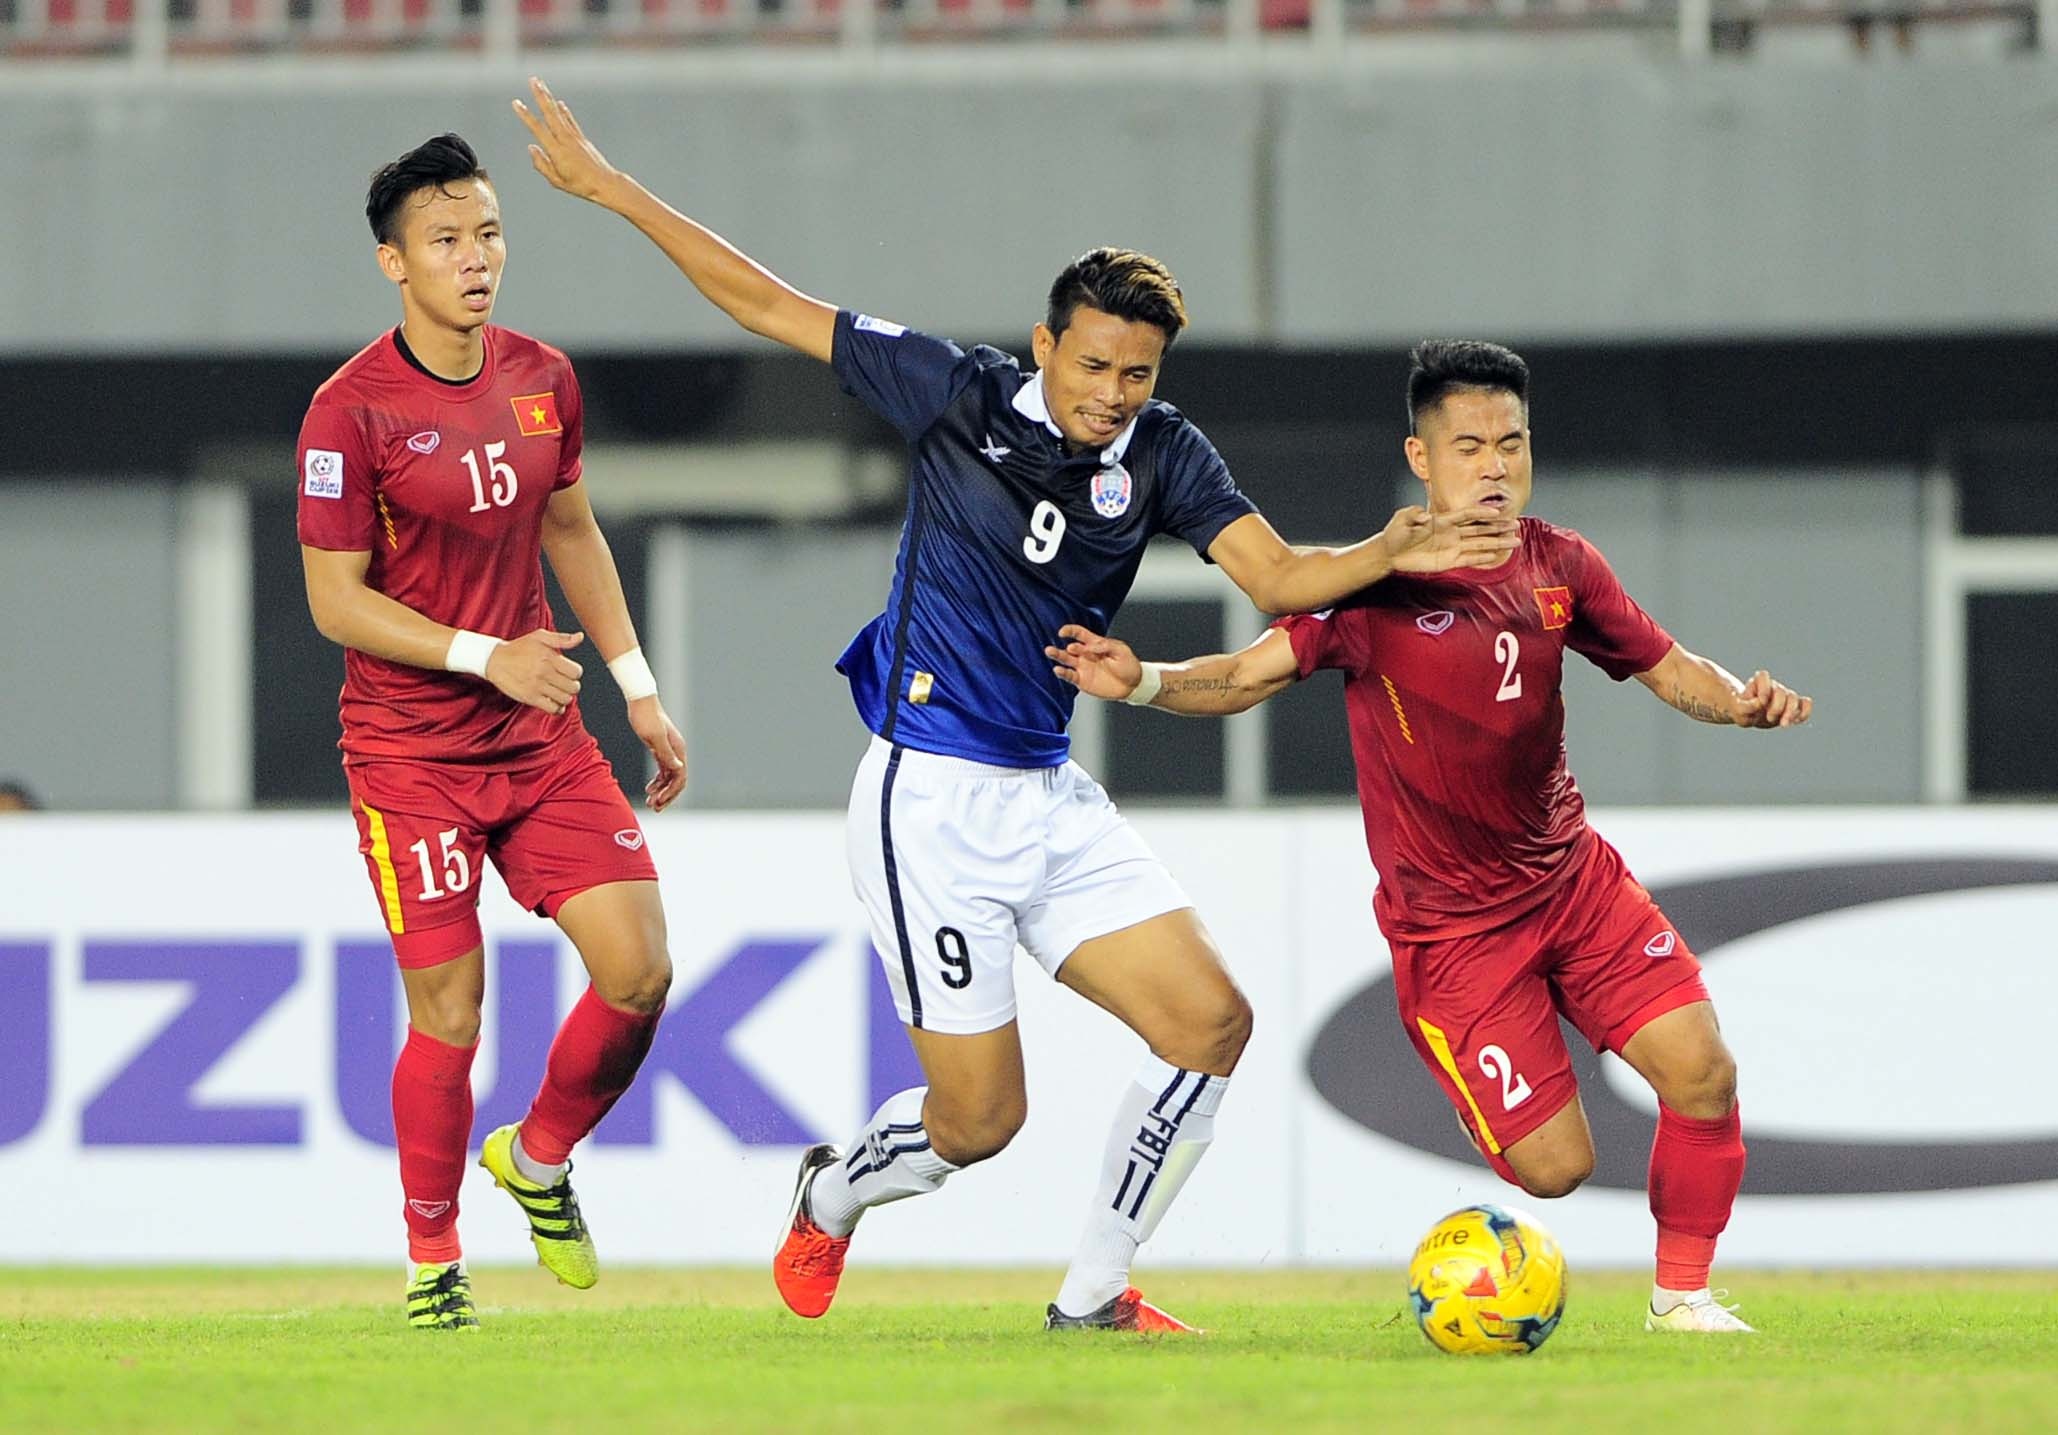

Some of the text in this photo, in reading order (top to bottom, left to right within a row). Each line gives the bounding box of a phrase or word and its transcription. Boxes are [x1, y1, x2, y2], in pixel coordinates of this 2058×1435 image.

[460, 439, 518, 513] 15
[1023, 499, 1067, 564] 9
[1494, 630, 1523, 702] 2
[409, 826, 471, 901] 15
[934, 926, 973, 989] 9
[0, 938, 930, 1149] ZUK
[1477, 1043, 1533, 1111] 2
[1130, 1109, 1180, 1174] FBT
